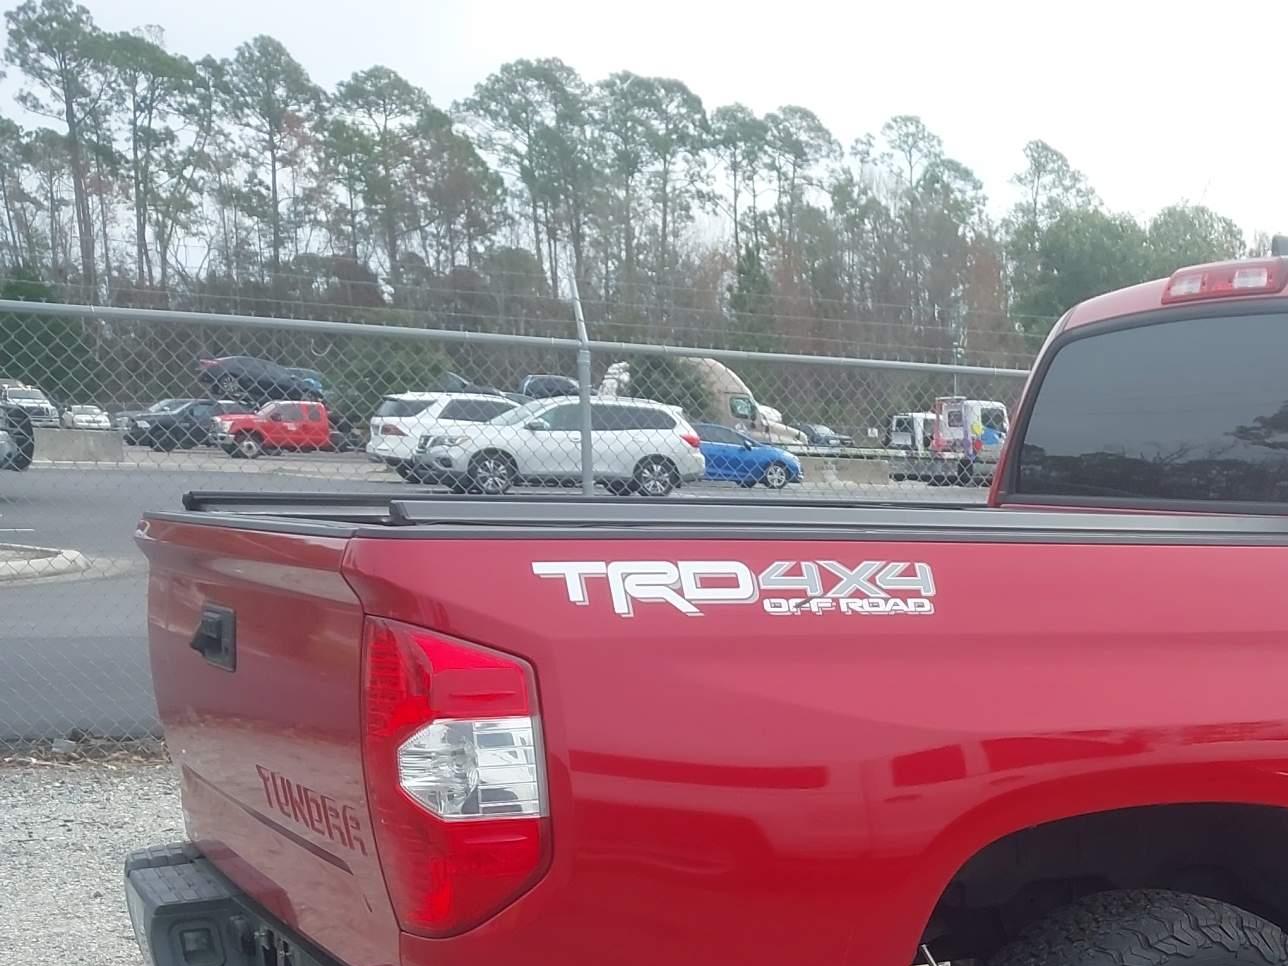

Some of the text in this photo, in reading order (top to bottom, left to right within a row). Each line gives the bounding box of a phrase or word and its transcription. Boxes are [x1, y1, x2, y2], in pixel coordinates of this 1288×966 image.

[531, 560, 759, 617] TRD
[762, 598, 935, 615] OFF ROAD
[255, 763, 369, 857] TUNDRA
